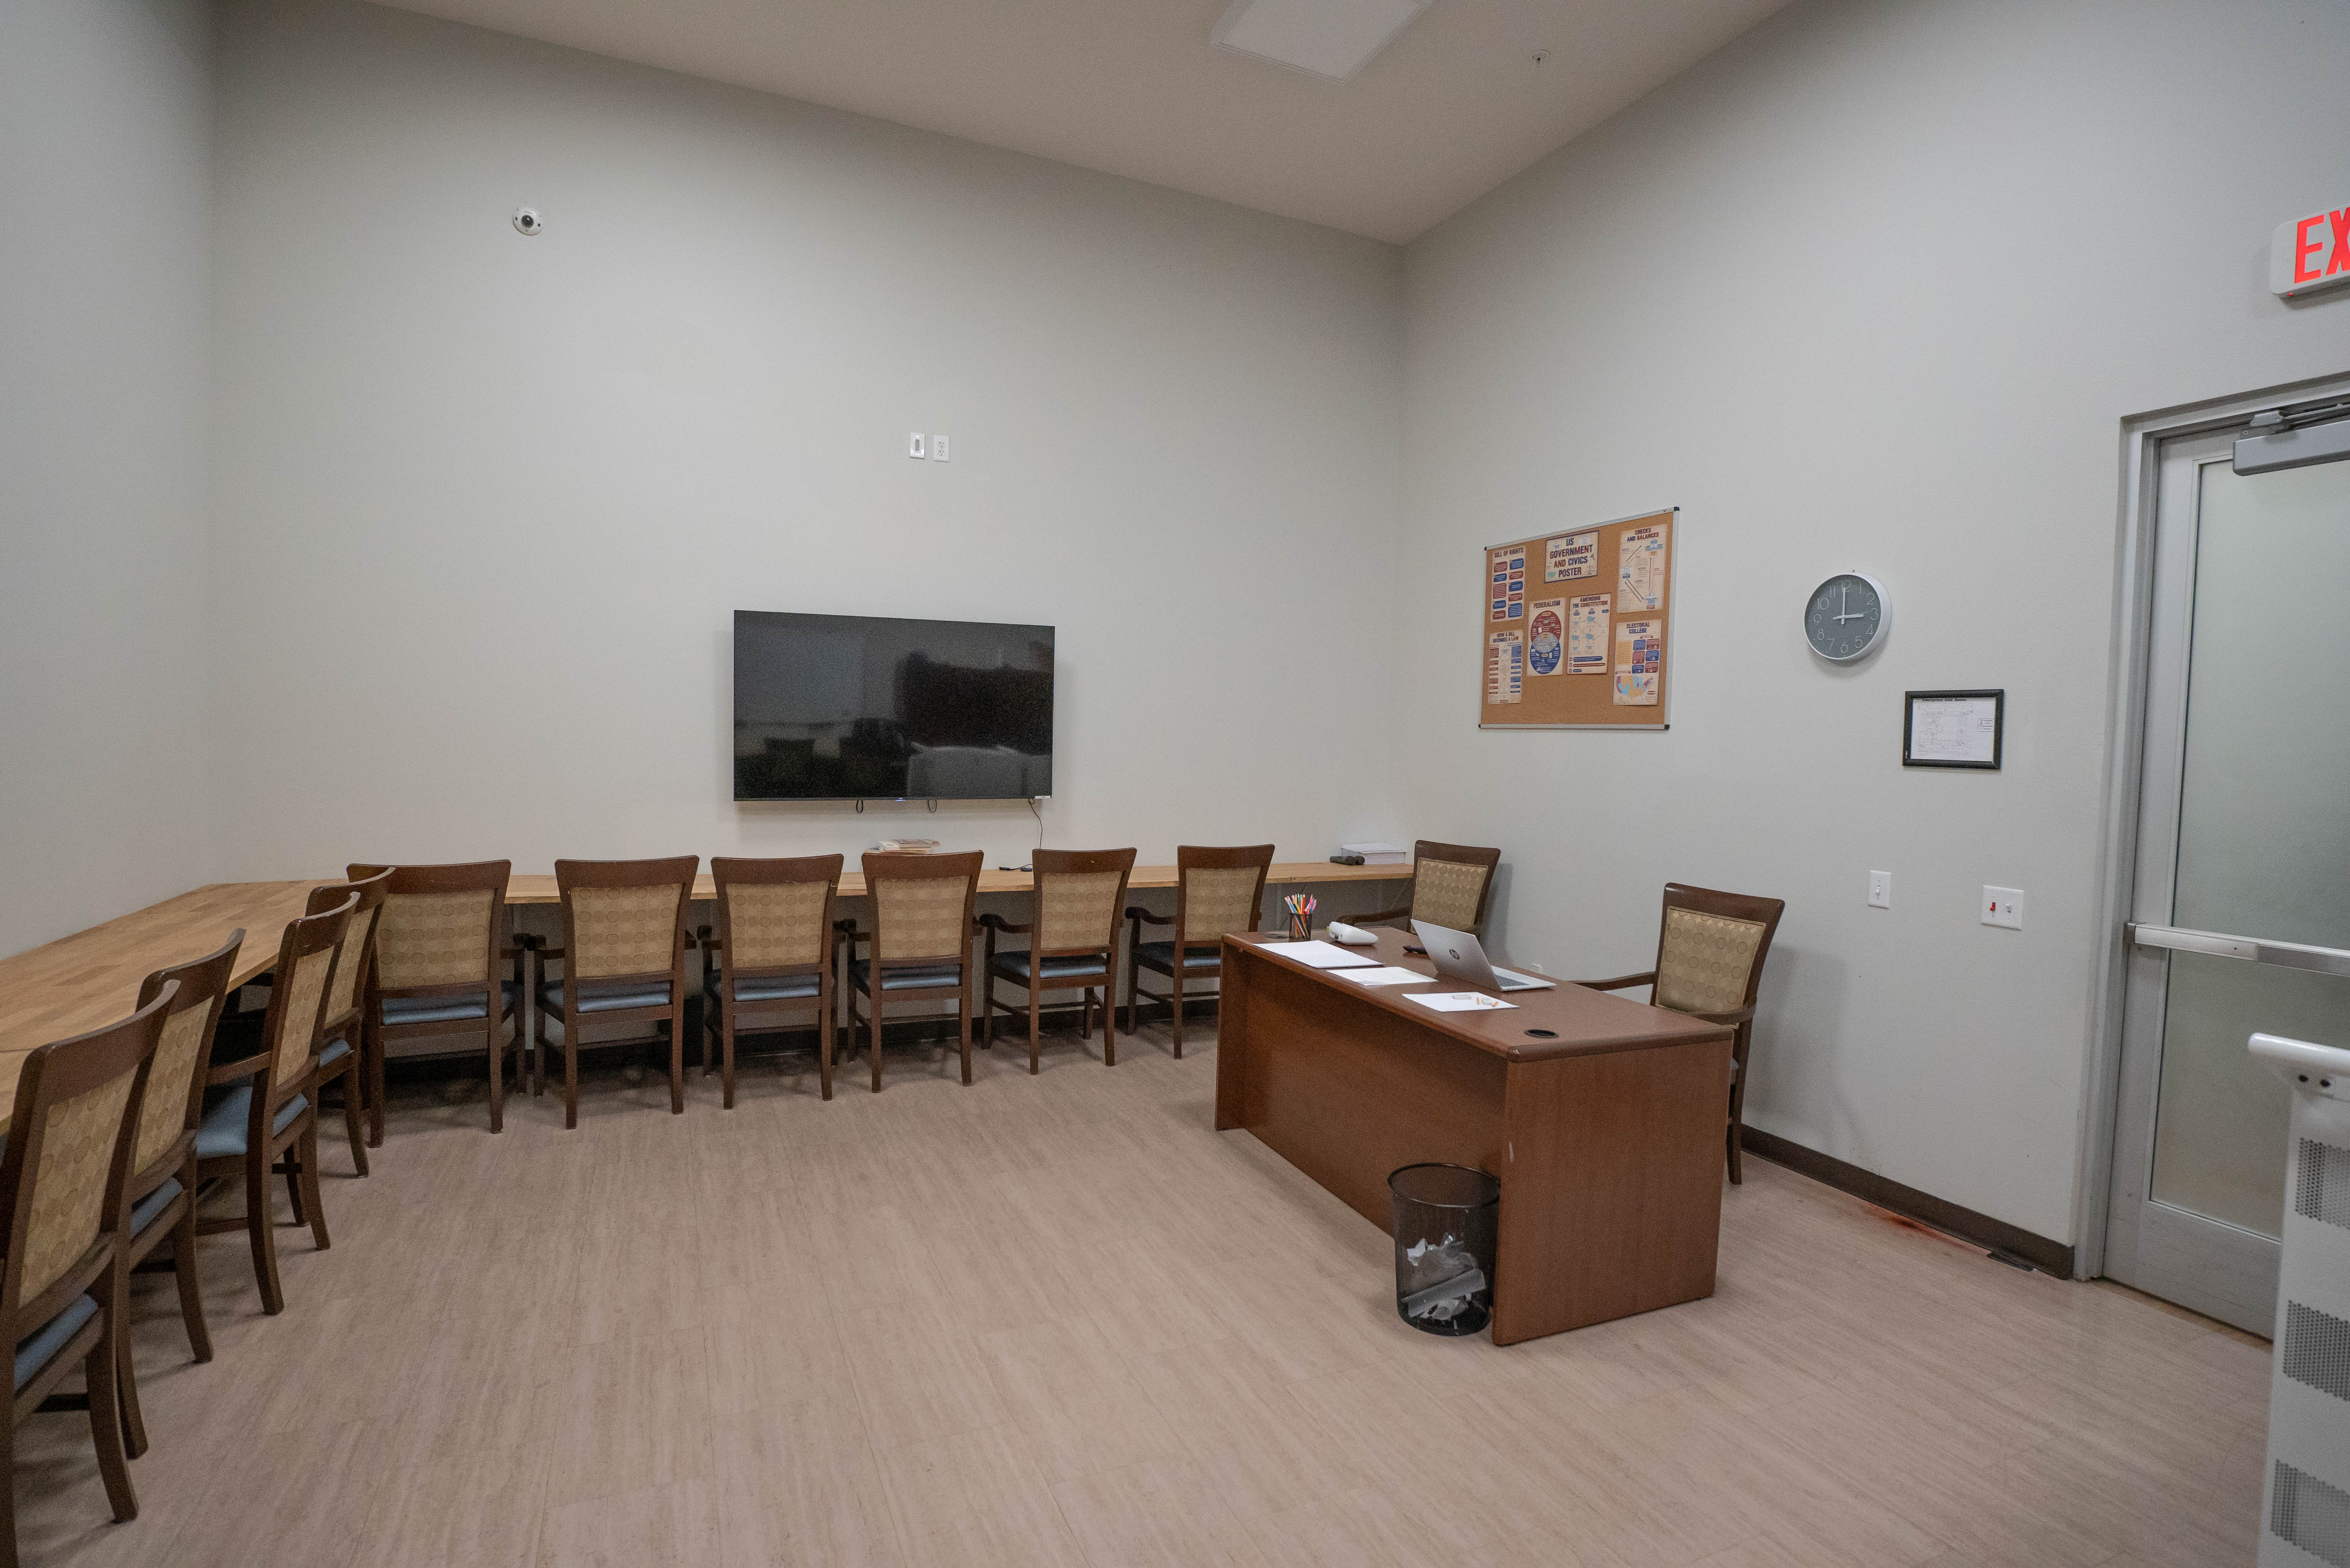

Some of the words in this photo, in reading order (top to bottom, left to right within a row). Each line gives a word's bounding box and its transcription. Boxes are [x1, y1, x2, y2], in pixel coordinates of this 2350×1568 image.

[1637, 532, 1659, 540] BALANCES
[1566, 538, 1574, 546] US
[1550, 544, 1593, 559] GOVERNMENT
[1554, 559, 1566, 568] AND
[1568, 556, 1587, 566] CIVICS
[1558, 567, 1582, 578] POSTER
[1829, 586, 1835, 598] 11
[1534, 600, 1561, 608] FEDERALISM
[1818, 598, 1829, 610] 10
[1867, 593, 1875, 605] 2
[1813, 614, 1821, 625] 9
[1870, 608, 1878, 620] 3
[1818, 629, 1824, 640] 8
[1866, 624, 1874, 635] 4
[1827, 638, 1834, 650] 7
[1841, 642, 1848, 653] 6
[1855, 636, 1863, 648] 5
[1449, 949, 1460, 960] hp
